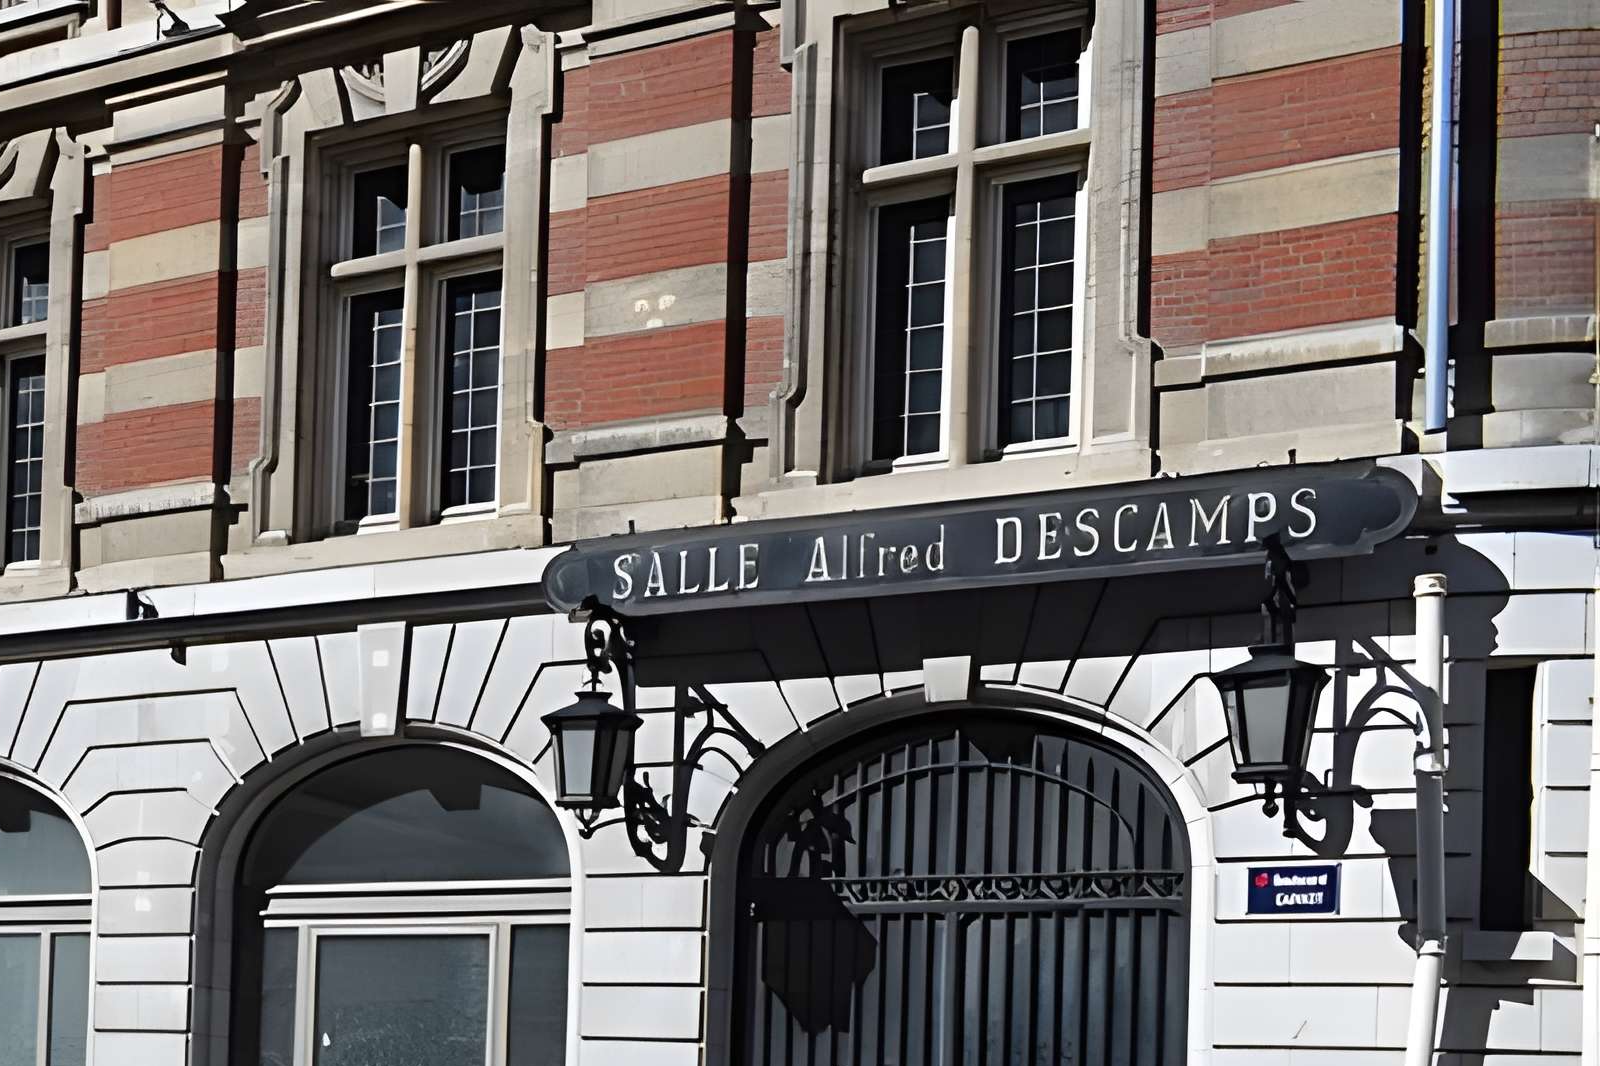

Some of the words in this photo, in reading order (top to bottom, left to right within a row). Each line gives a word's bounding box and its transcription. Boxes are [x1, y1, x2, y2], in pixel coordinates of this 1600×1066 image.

[612, 542, 760, 600] SALLE
[804, 523, 945, 583] Alfred
[994, 487, 1317, 565] DESCAMPS
